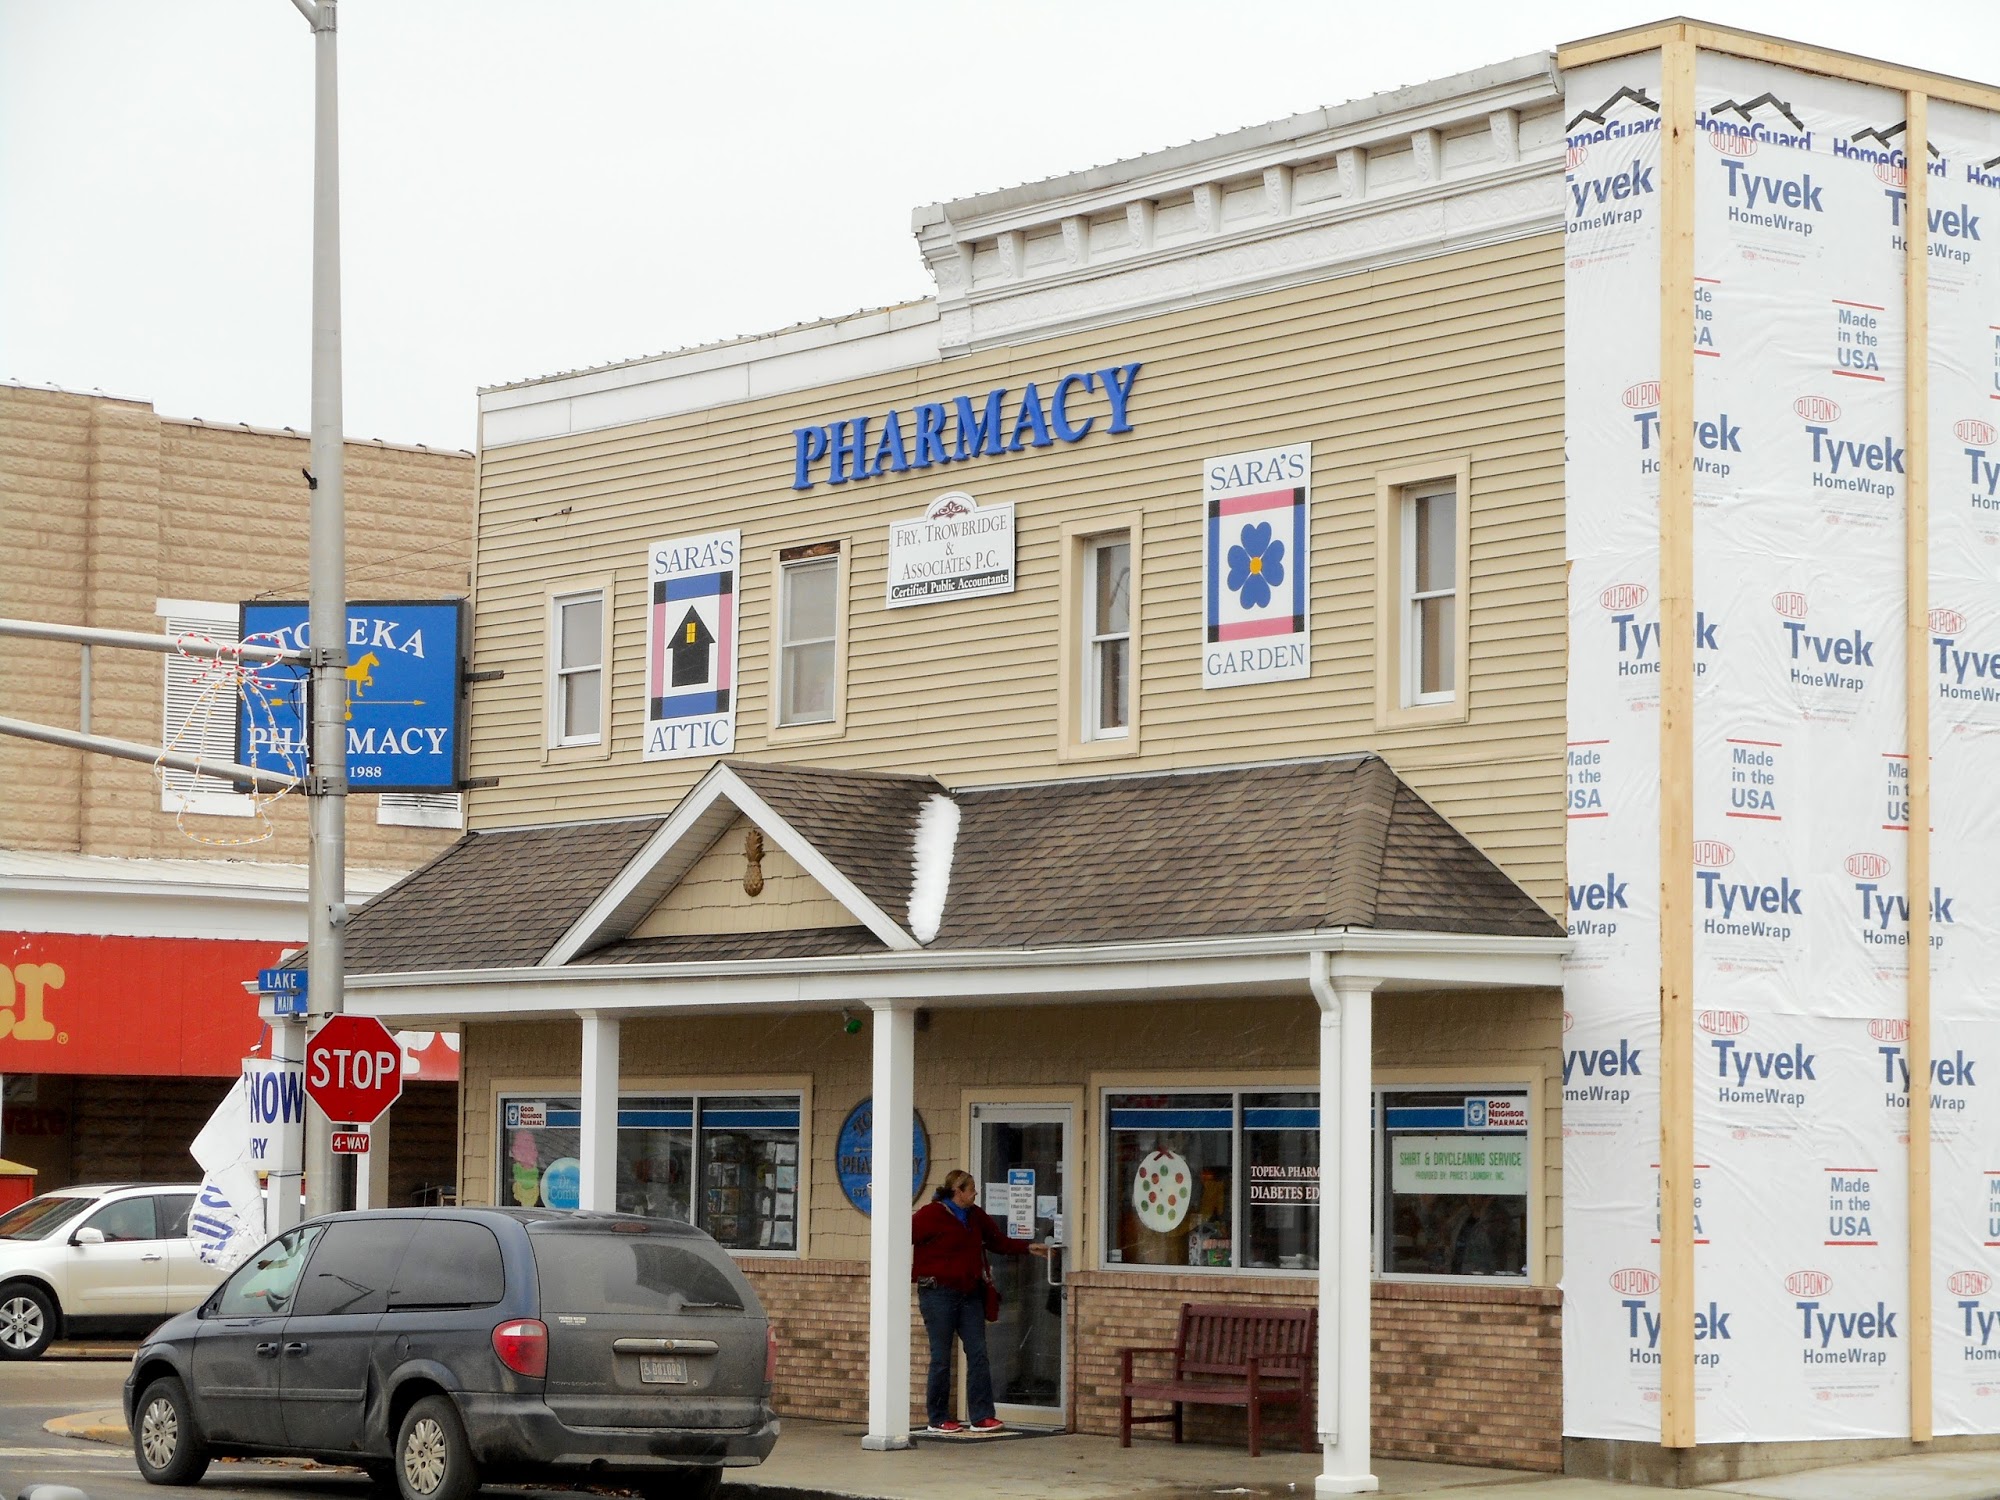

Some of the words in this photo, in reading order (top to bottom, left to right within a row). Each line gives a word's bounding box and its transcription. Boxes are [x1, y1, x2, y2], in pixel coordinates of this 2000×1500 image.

[1833, 138, 1947, 178] HomeGrd
[1721, 158, 1824, 213] Tyvek
[1728, 206, 1813, 237] HomeWrap
[1885, 189, 1981, 241] Tvek
[1838, 309, 1877, 329] Made
[1838, 327, 1850, 343] in
[1856, 331, 1877, 347] the
[1838, 347, 1879, 371] USA
[791, 362, 1143, 491] PHARMACY
[1805, 425, 1905, 474] Tyvek
[1210, 453, 1304, 491] SARA'S
[1813, 472, 1895, 499] HomeWrap
[925, 515, 1008, 542] TROWBRIDGE
[655, 540, 734, 575] SARA'S
[945, 541, 954, 556] &
[902, 555, 971, 580] ASSOCIATES
[975, 550, 999, 569] P.C.
[892, 582, 928, 598] Certified
[931, 578, 955, 594] Public
[958, 573, 1008, 589] Accountants
[271, 618, 425, 659] TOEKA
[1207, 643, 1305, 677] GARDEN
[247, 727, 447, 755] PHAMACY
[649, 719, 730, 754] ATTIC
[1733, 748, 1774, 766] Made
[350, 766, 382, 778] 1988
[1579, 769, 1601, 784] the
[1732, 767, 1746, 783] in
[1751, 769, 1774, 785] the
[1732, 788, 1775, 810] USA
[1888, 781, 1899, 796] in
[1568, 873, 1629, 911] vek
[1696, 871, 1803, 919] Tyvek
[1704, 919, 1791, 941] HomeWrap
[267, 973, 297, 989] LAKE
[277, 995, 294, 1012] MAIN
[310, 1048, 396, 1090] STOP
[1562, 1039, 1643, 1086] yvek
[1711, 1039, 1816, 1087] Tyvek
[1719, 1087, 1805, 1108] HomeWrap
[250, 1138, 268, 1159] RY
[333, 1136, 368, 1150] 4-WAY
[1250, 1165, 1286, 1177] TOPEKA
[1400, 1151, 1421, 1166] SHIRT
[1488, 1152, 1522, 1167] SERVICE
[1250, 1186, 1304, 1199] DIABETES
[1831, 1177, 1870, 1192] Made
[1830, 1196, 1843, 1211] in
[1848, 1197, 1871, 1211] the
[1829, 1216, 1872, 1236] USA
[1622, 1300, 1731, 1348] Tyek
[1796, 1301, 1898, 1348] Tyvek
[1804, 1348, 1887, 1366] HomeWrap
